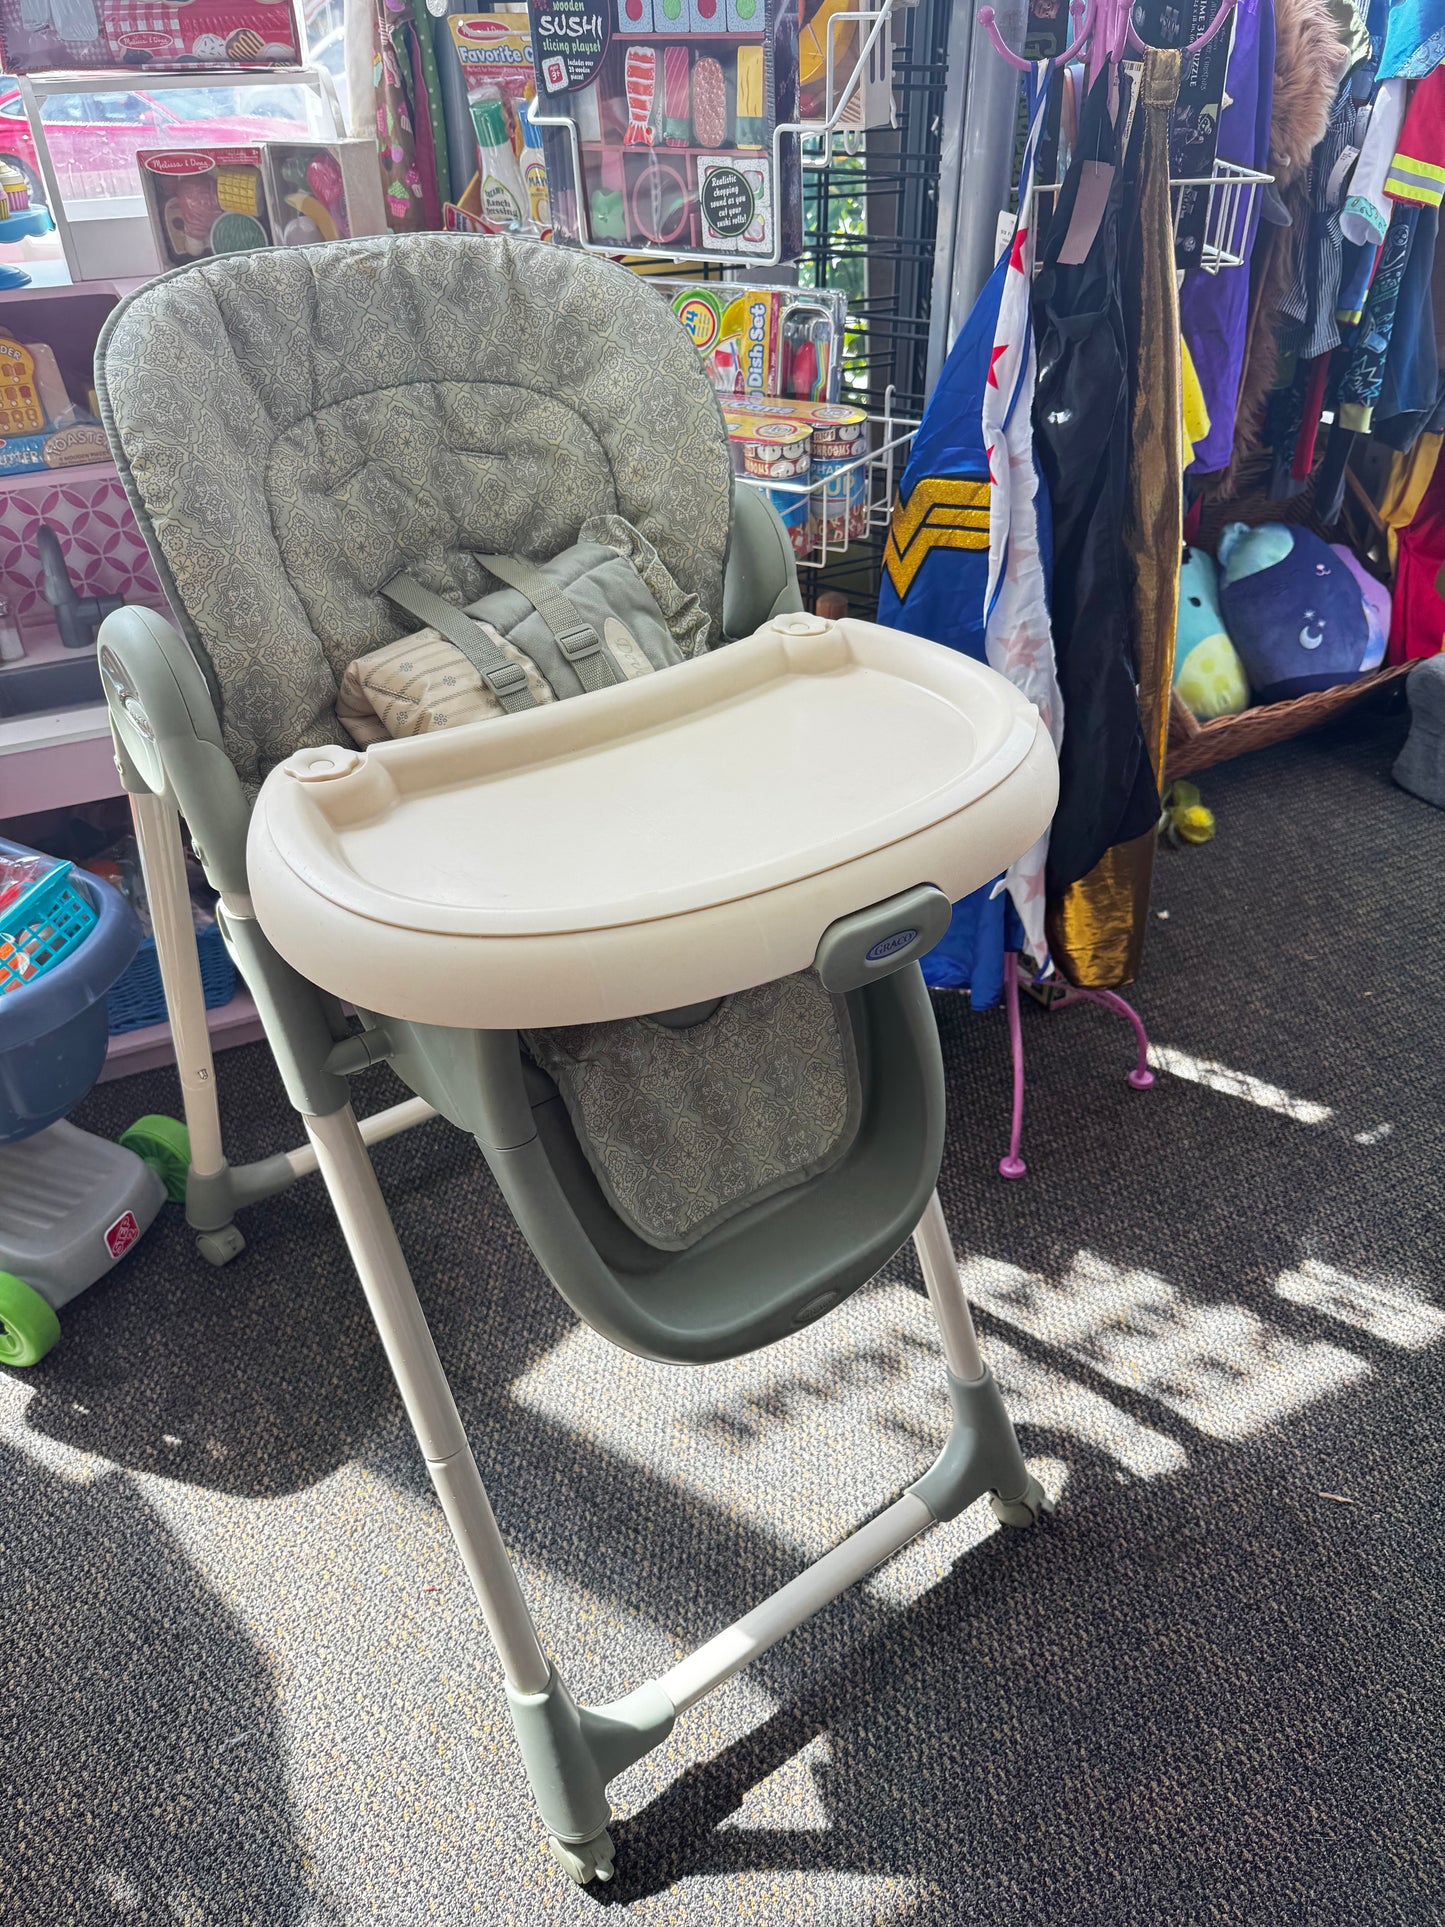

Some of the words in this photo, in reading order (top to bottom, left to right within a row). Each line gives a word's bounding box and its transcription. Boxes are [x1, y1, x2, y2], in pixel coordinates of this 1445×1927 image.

[552, 0, 585, 11] wooden
[538, 13, 603, 39] SUSHI
[458, 46, 523, 64] Favorite
[543, 38, 570, 54] slicing
[571, 39, 601, 55] playset
[1189, 46, 1203, 88] UZZLE
[152, 160, 184, 170] Melissa
[190, 158, 210, 170] Doug
[711, 174, 737, 187] Realistic
[713, 186, 739, 198] chopping
[710, 197, 727, 208] sound
[717, 217, 731, 228] sushi
[684, 310, 698, 336] 24
[749, 303, 766, 342] Set
[748, 344, 764, 388] Dish
[728, 400, 797, 414] Cans
[874, 932, 915, 957] GRACO
[113, 1215, 130, 1254] STEP
